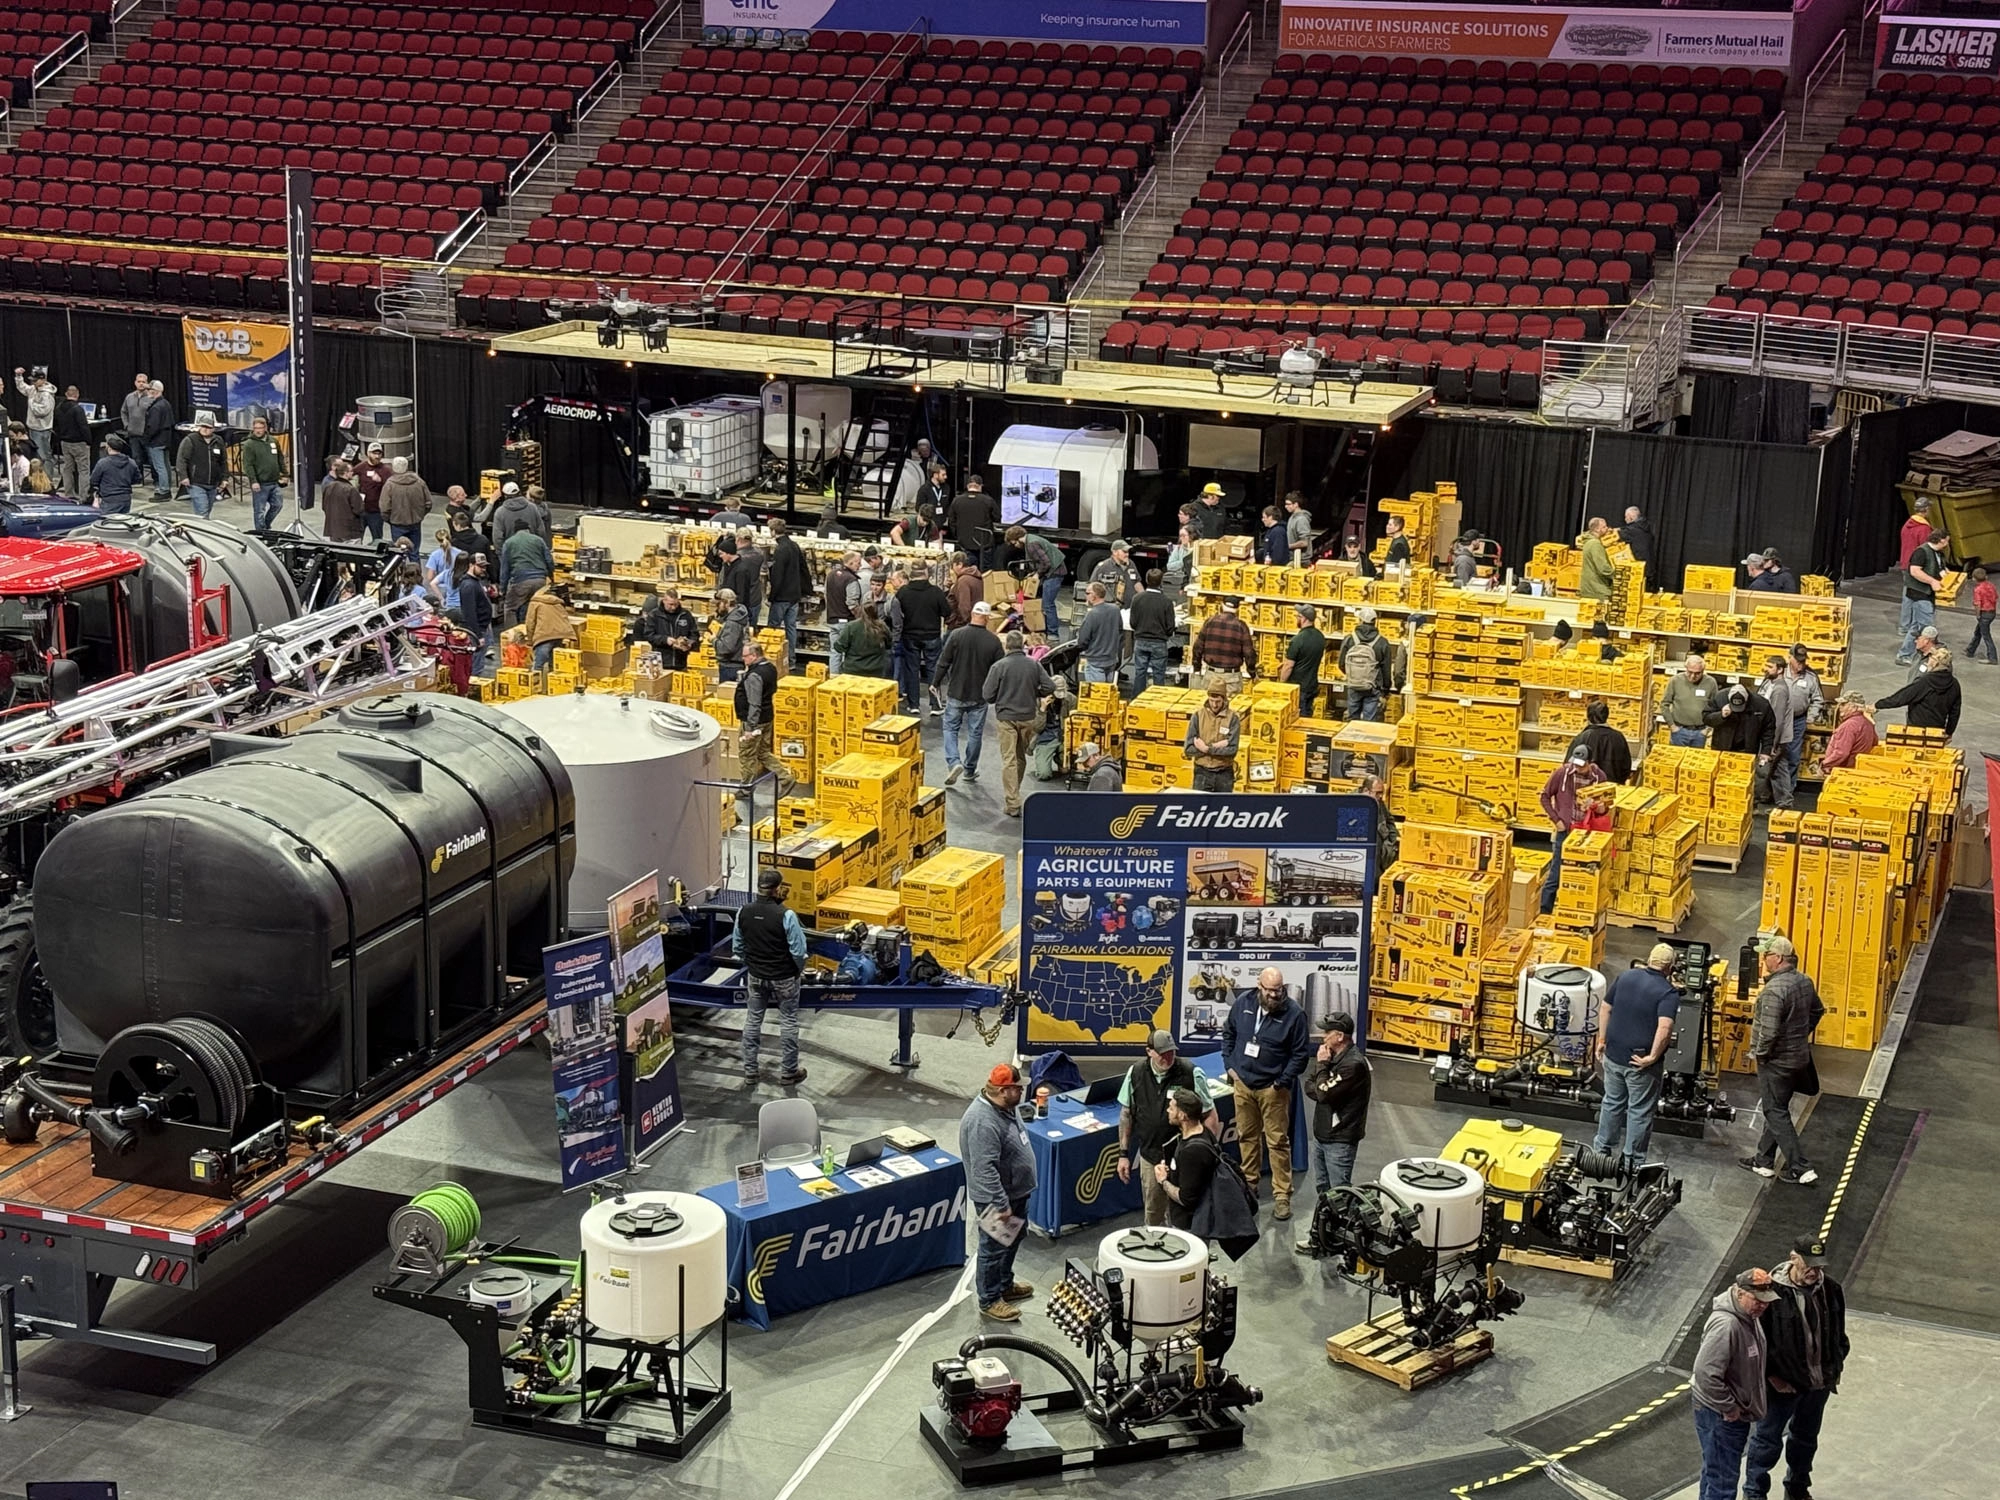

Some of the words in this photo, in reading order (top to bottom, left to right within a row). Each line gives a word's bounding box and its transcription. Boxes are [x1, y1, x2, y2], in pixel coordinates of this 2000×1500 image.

[733, 12, 777, 20] INSURANCE
[1040, 13, 1084, 27] Keeping
[1087, 15, 1138, 26] insurance
[1141, 16, 1180, 28] human
[1289, 17, 1372, 32] INNOVATIVE
[1376, 20, 1459, 34] INSURANCE
[1463, 22, 1549, 37] SOLUTIONS
[1288, 33, 1314, 46] FOR
[1317, 34, 1386, 48] AMERICA'S
[1389, 36, 1451, 50] FARMERS
[1665, 33, 1713, 45] Farmers
[1715, 35, 1758, 47] Mutual
[1760, 36, 1784, 48] Hail
[1664, 45, 1706, 54] Insurance
[1708, 47, 1747, 57] Company
[1750, 47, 1759, 55] of
[1762, 48, 1783, 56] Iowa
[195, 326, 252, 355] D&B
[1285, 751, 1299, 759] XR
[1157, 805, 1289, 828] Fairbank
[446, 826, 486, 859] Fairbank
[1054, 845, 1110, 856] Whatever
[1113, 847, 1122, 856] It
[1127, 847, 1159, 857] Takes
[1037, 859, 1174, 873] AGRICULTURE
[1037, 877, 1079, 888] PARTS
[1083, 878, 1092, 888] &
[1095, 878, 1174, 888] EQUIPMENT
[1030, 945, 1098, 954] FAIRBANK
[1101, 946, 1175, 955] LOCATIONS
[1318, 964, 1359, 972] Novid
[561, 974, 597, 990] Automated
[554, 984, 585, 1000] Chemical
[585, 981, 605, 992] Mixing
[652, 1095, 673, 1116] NEWTON
[653, 1104, 674, 1127] CROUCH
[796, 1185, 967, 1268] Fairbank
[599, 1275, 631, 1289] Fairbank
